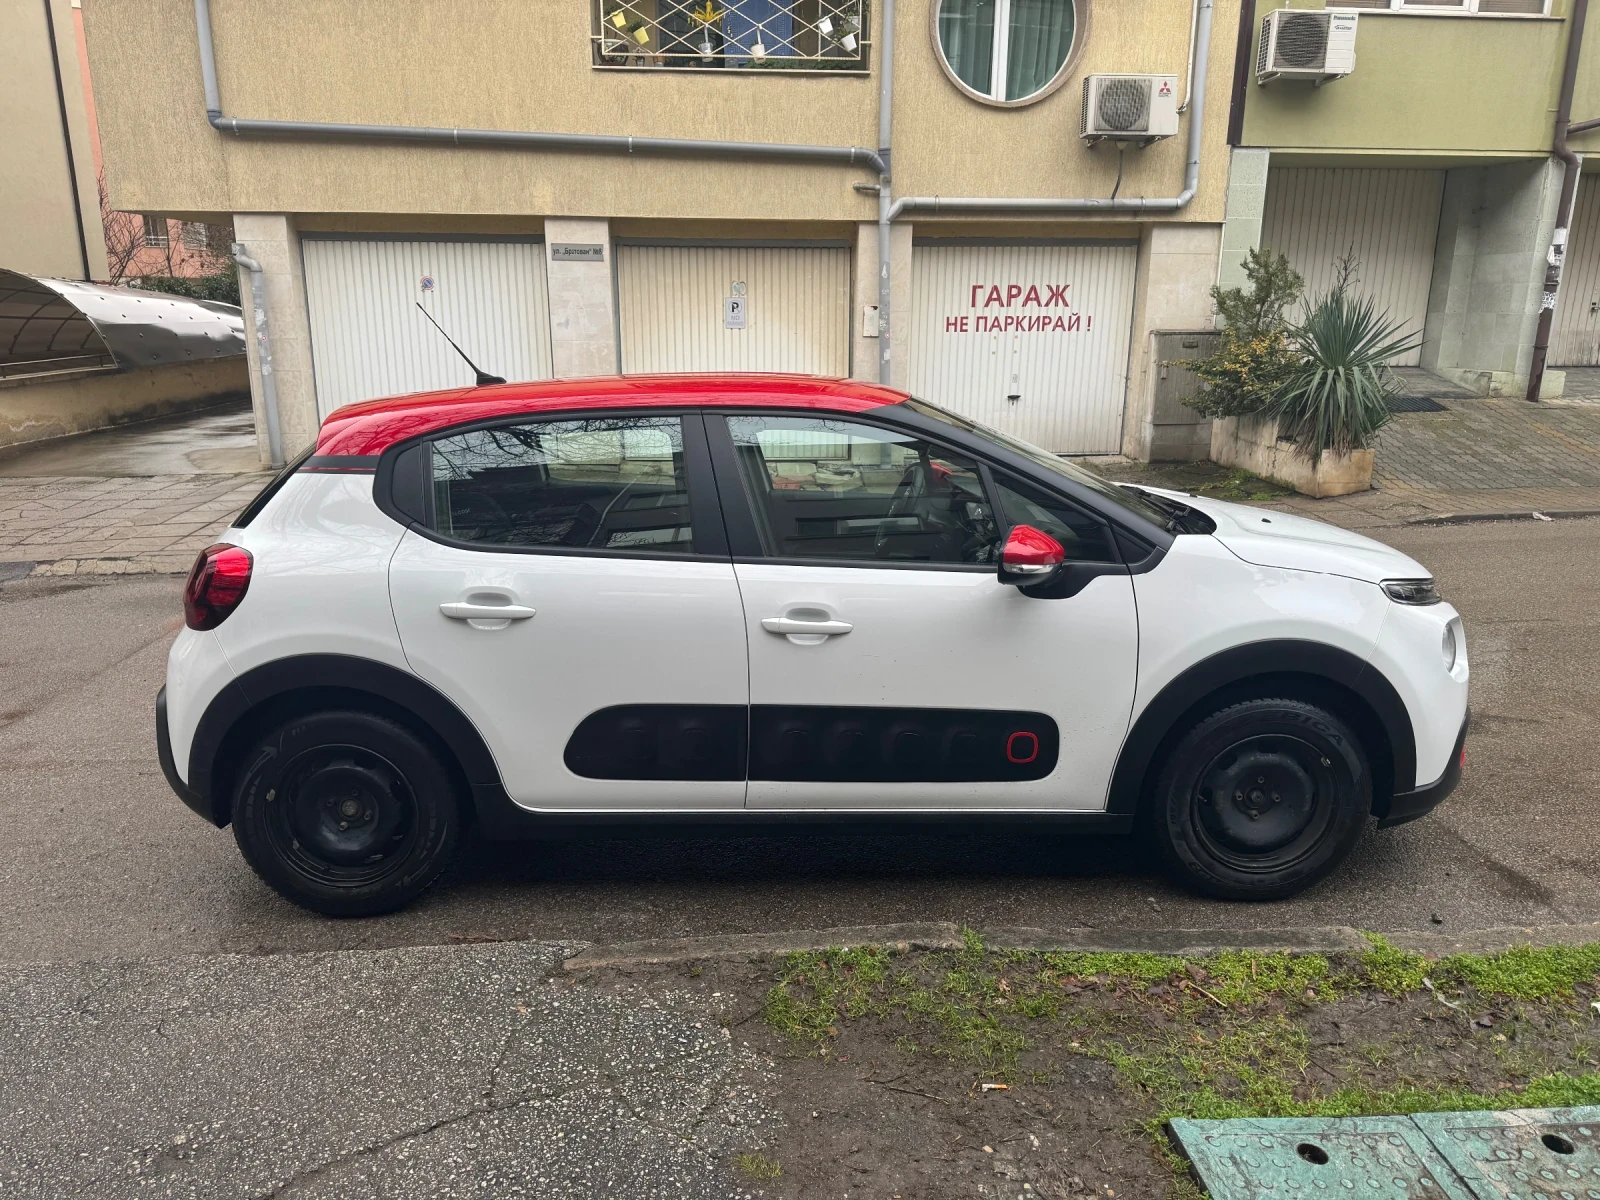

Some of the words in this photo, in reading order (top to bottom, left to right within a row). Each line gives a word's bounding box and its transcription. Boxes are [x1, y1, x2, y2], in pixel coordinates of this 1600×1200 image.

[552, 248, 561, 256] ул.
[970, 284, 1071, 308] ГАРАЖ
[945, 315, 969, 333] НЕ
[975, 312, 1081, 333] ПАРКИРАЙ
[1086, 315, 1092, 332] !
